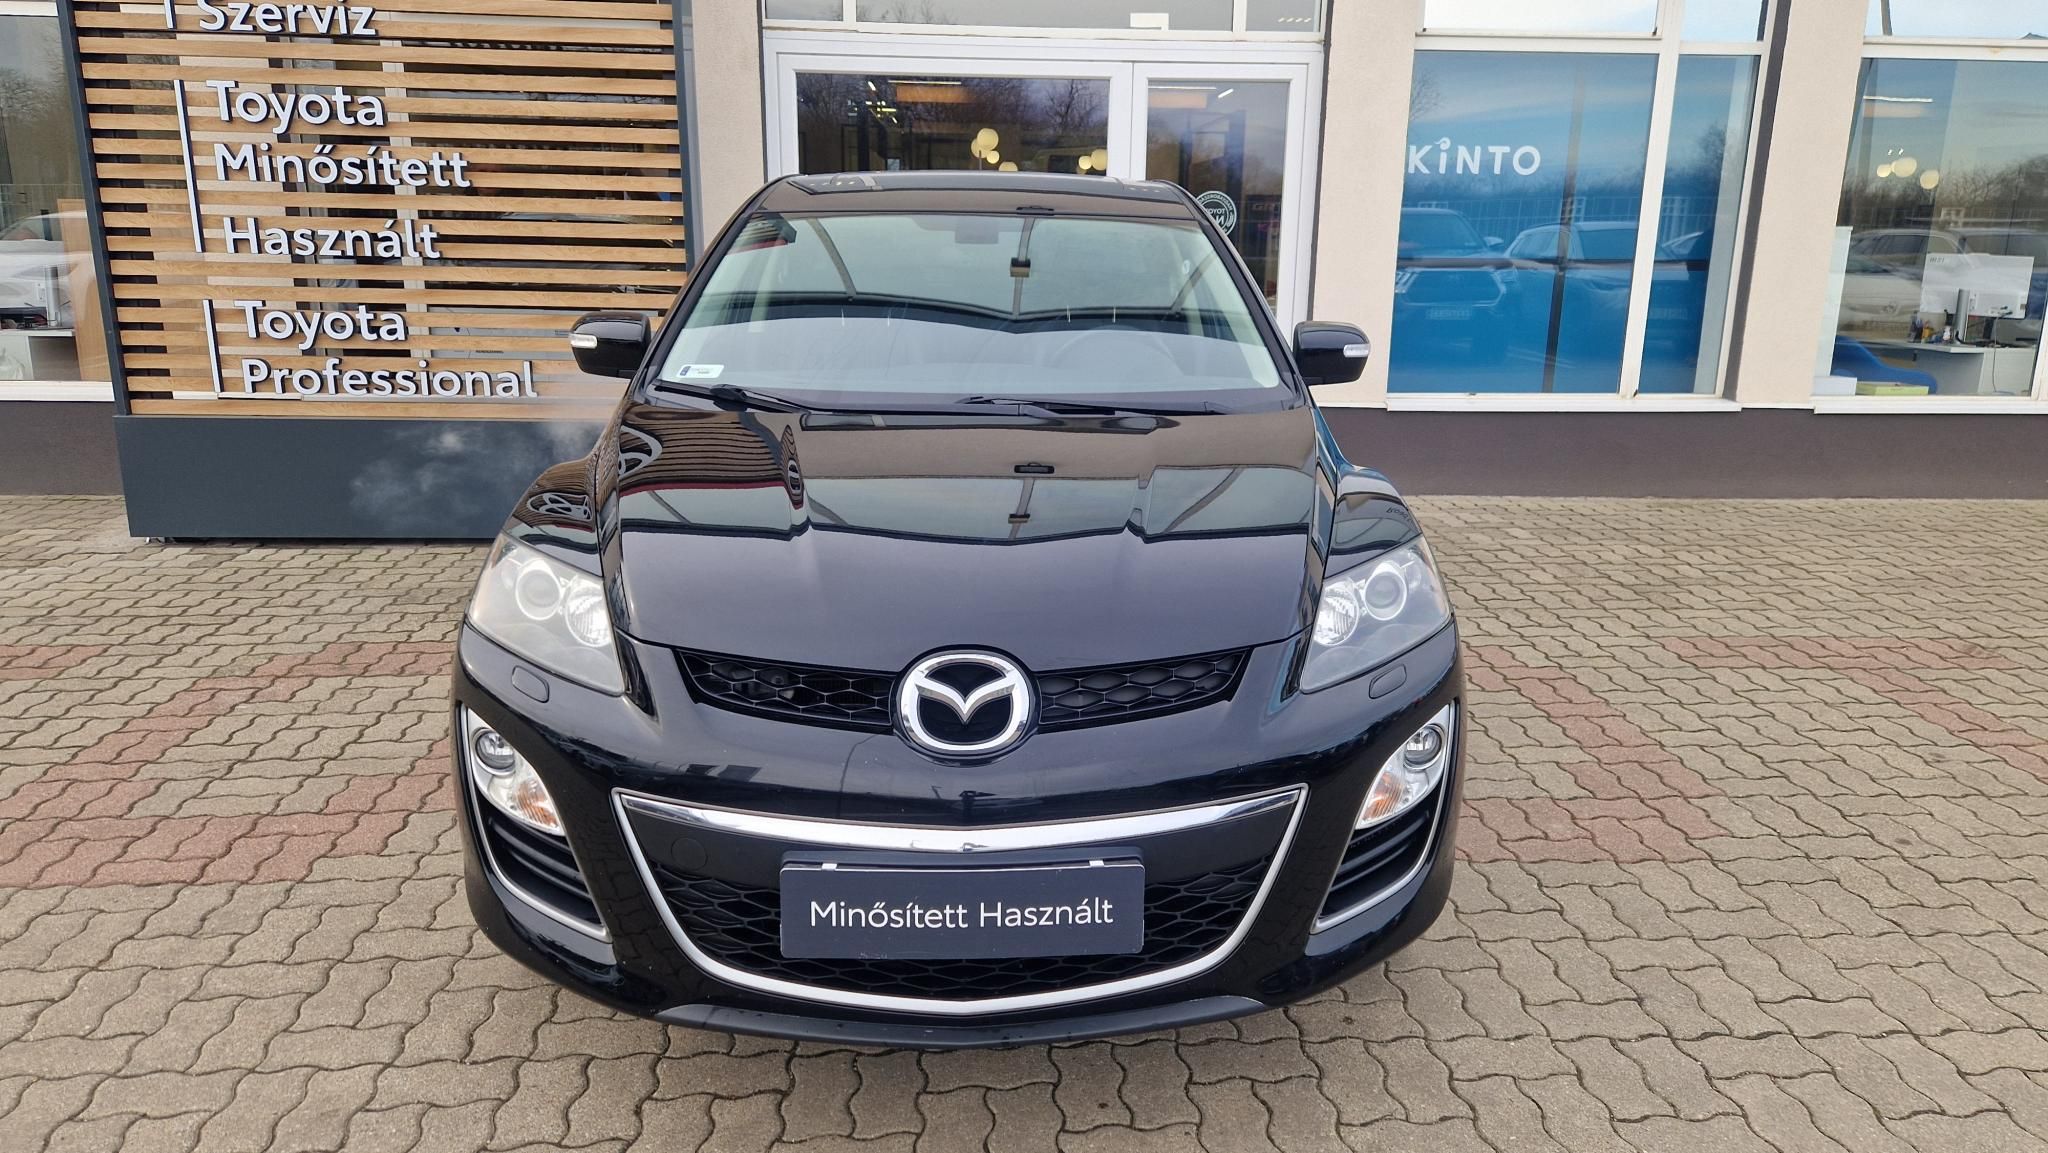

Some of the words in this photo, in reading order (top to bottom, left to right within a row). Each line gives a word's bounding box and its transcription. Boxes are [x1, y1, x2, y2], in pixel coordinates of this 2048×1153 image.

[197, 0, 377, 36] Szerviz
[206, 79, 386, 135] Toyota
[213, 142, 472, 188] Minősített
[223, 215, 443, 259] Használt
[234, 300, 408, 351] Toyota
[240, 357, 539, 398] Professional
[809, 900, 969, 929] Minősített
[978, 896, 1115, 928] Használt
